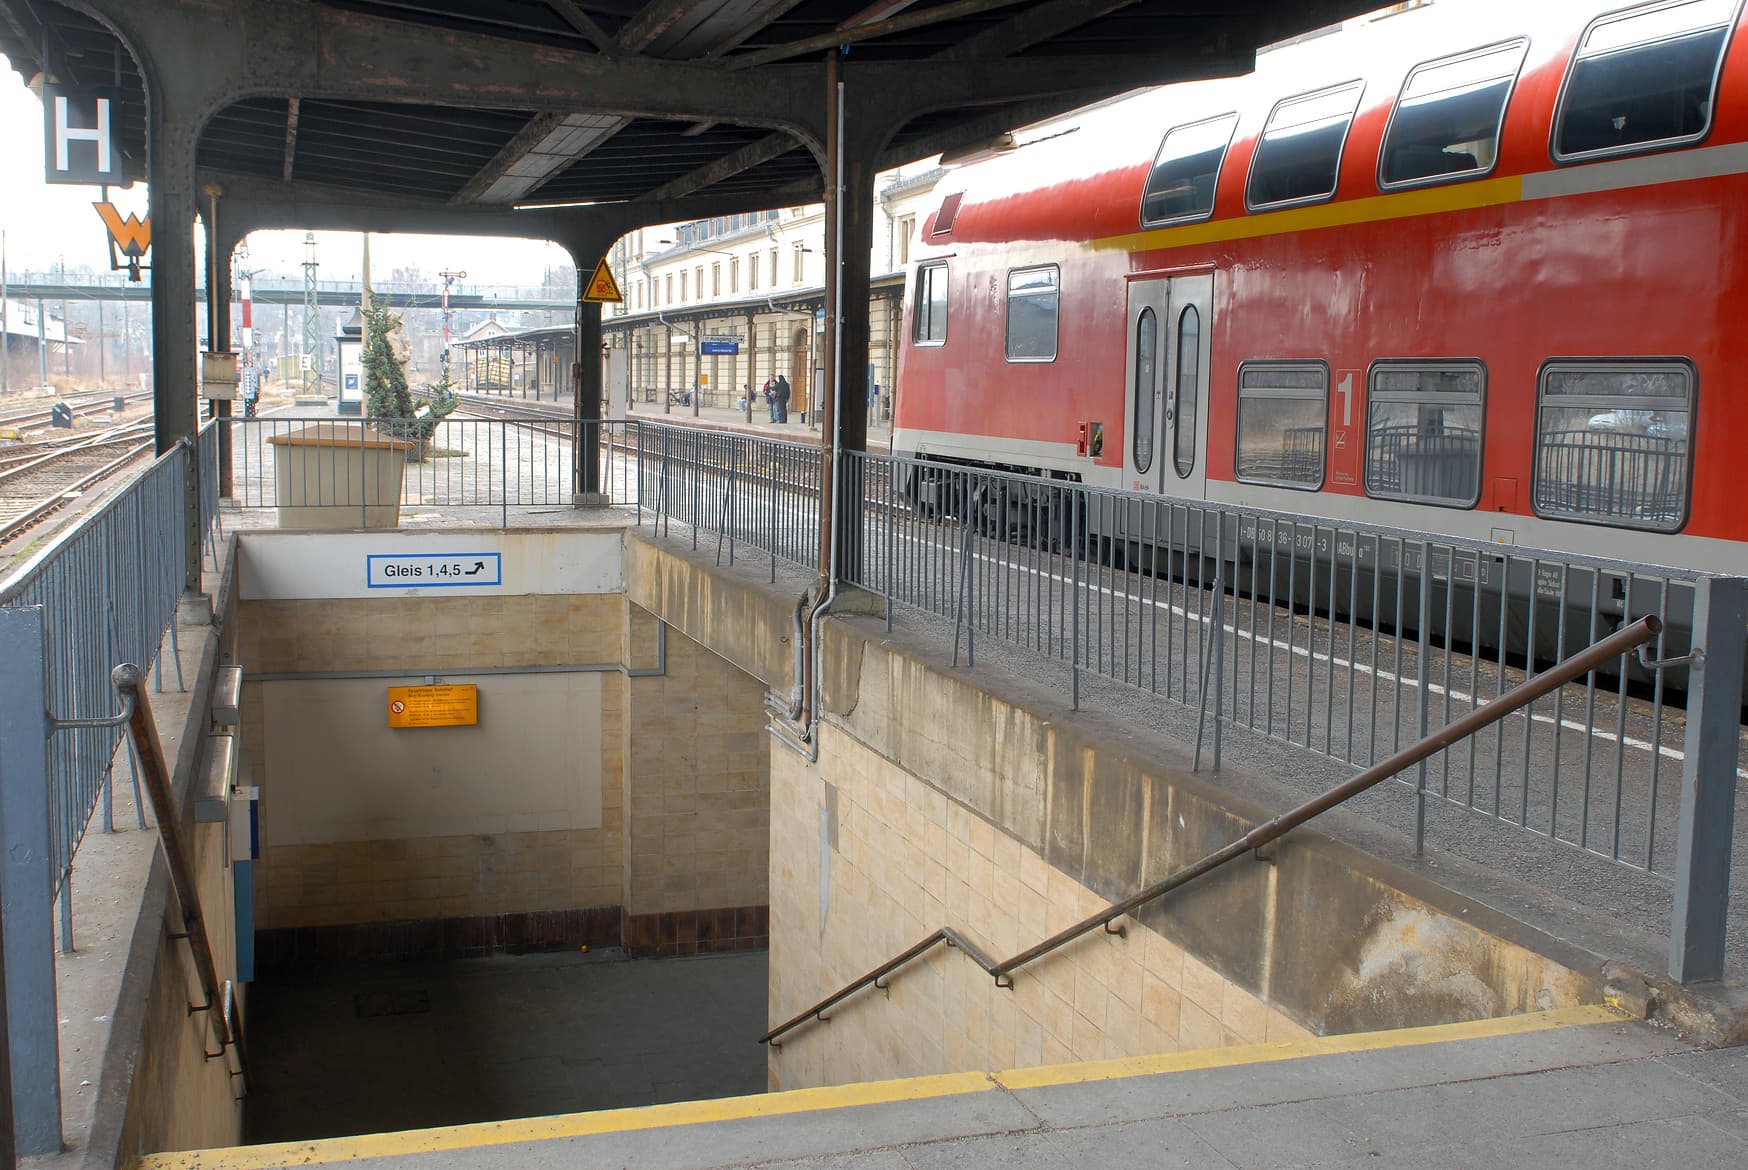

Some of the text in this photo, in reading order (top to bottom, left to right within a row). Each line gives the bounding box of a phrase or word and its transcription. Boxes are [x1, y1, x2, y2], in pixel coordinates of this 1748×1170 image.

[54, 96, 112, 173] H
[1337, 372, 1353, 427] 1
[384, 563, 461, 578] Gleis 1,4,5
